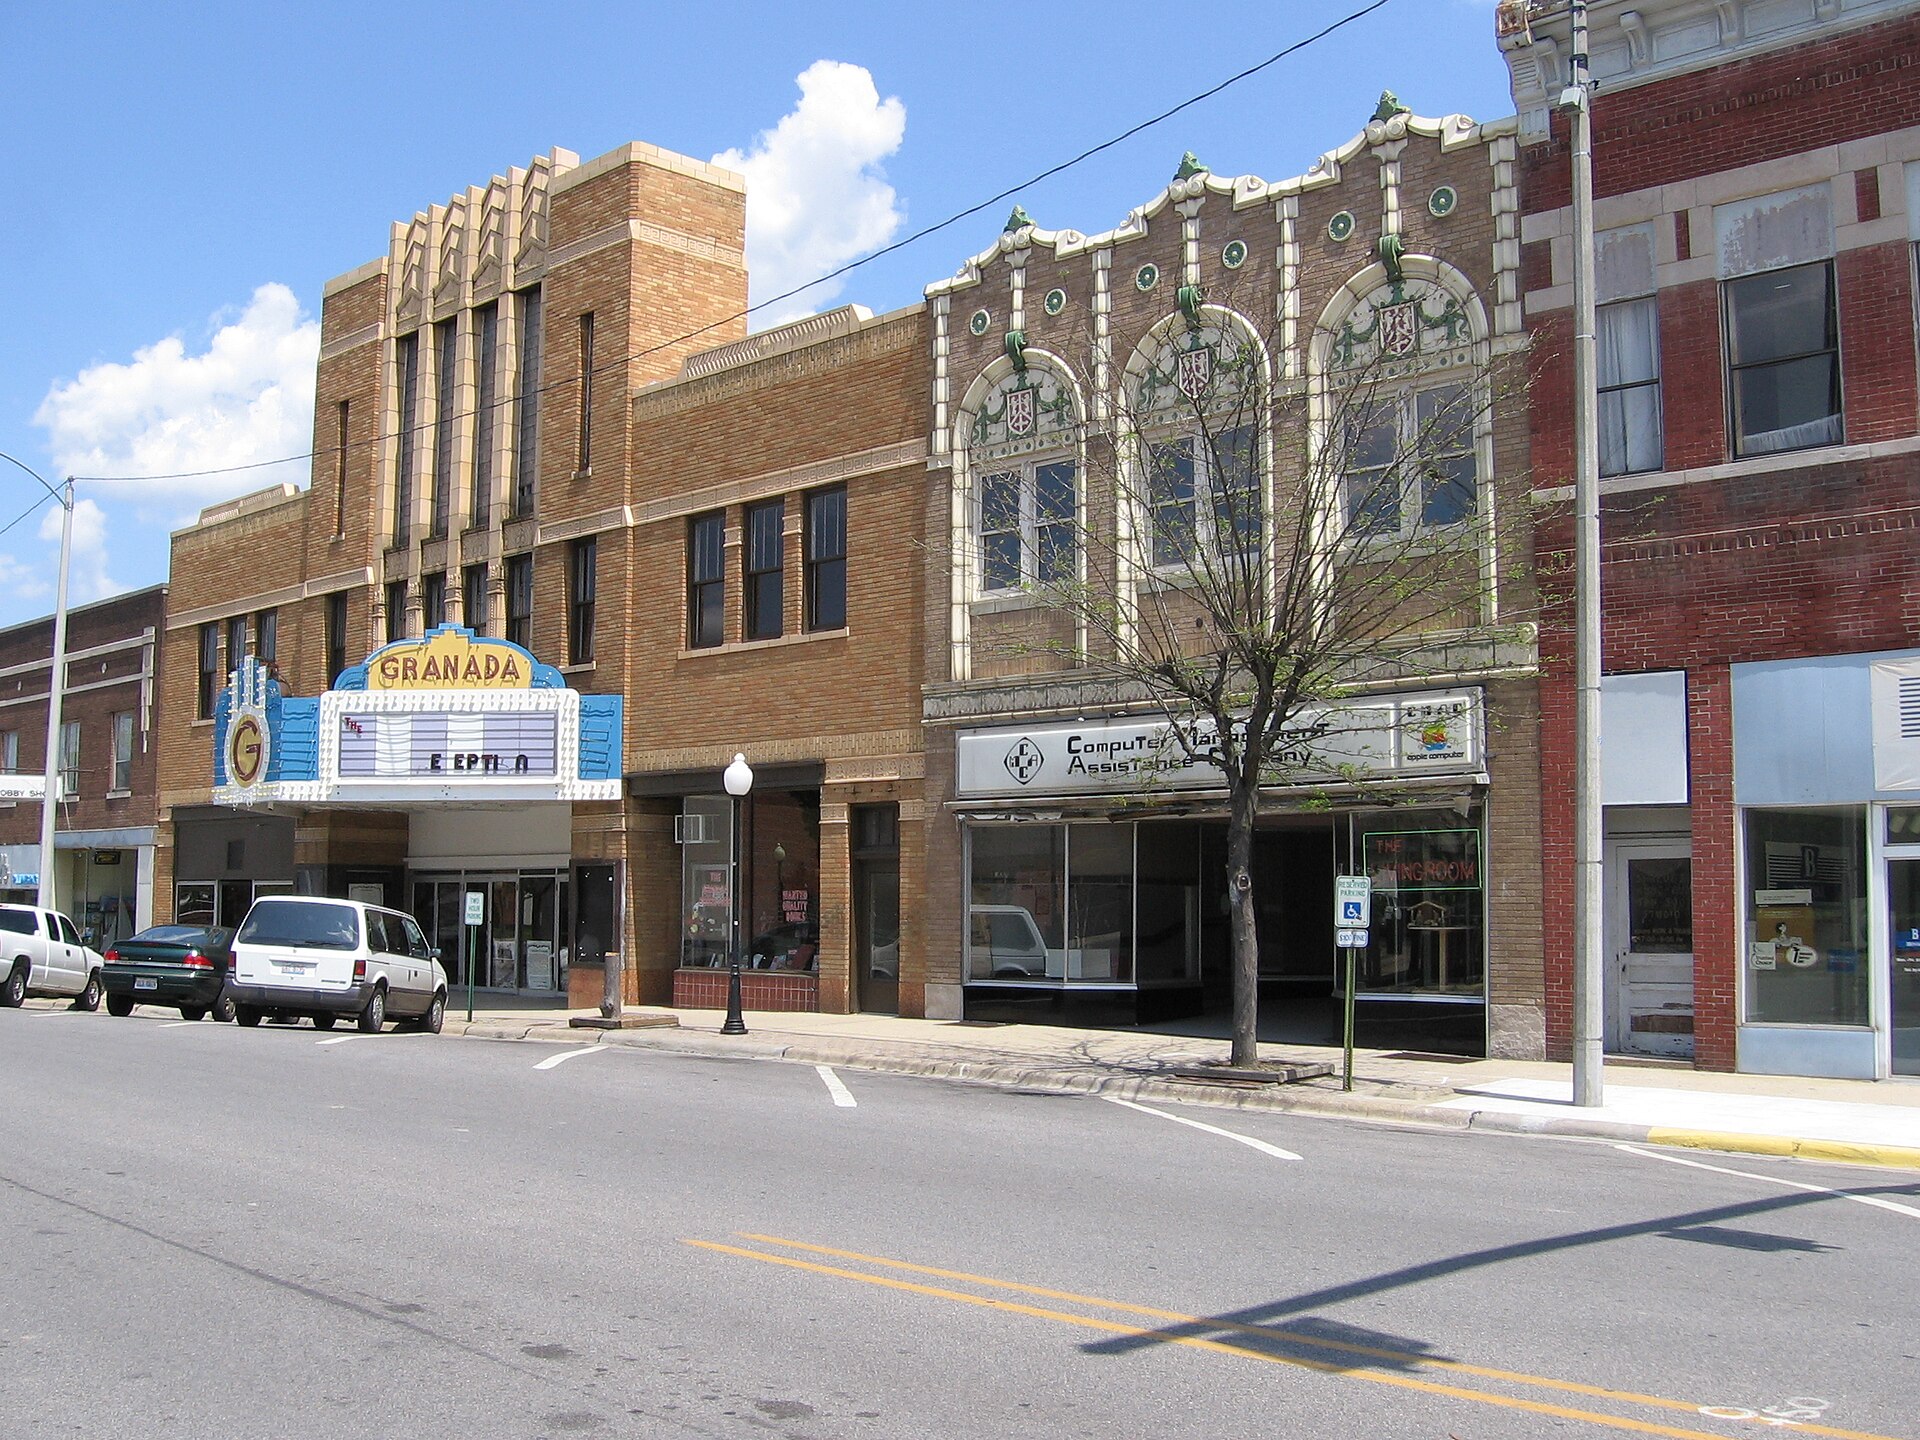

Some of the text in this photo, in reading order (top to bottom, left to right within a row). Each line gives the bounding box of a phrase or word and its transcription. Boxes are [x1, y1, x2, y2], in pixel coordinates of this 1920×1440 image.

[380, 654, 521, 681] GRANADA
[344, 717, 363, 734] THE
[233, 720, 261, 781] G
[1428, 751, 1465, 760] computer
[1376, 838, 1402, 853] THE
[1339, 881, 1368, 889] RESERVED
[782, 900, 808, 911] QUALITY
[1353, 934, 1366, 942] FINE
